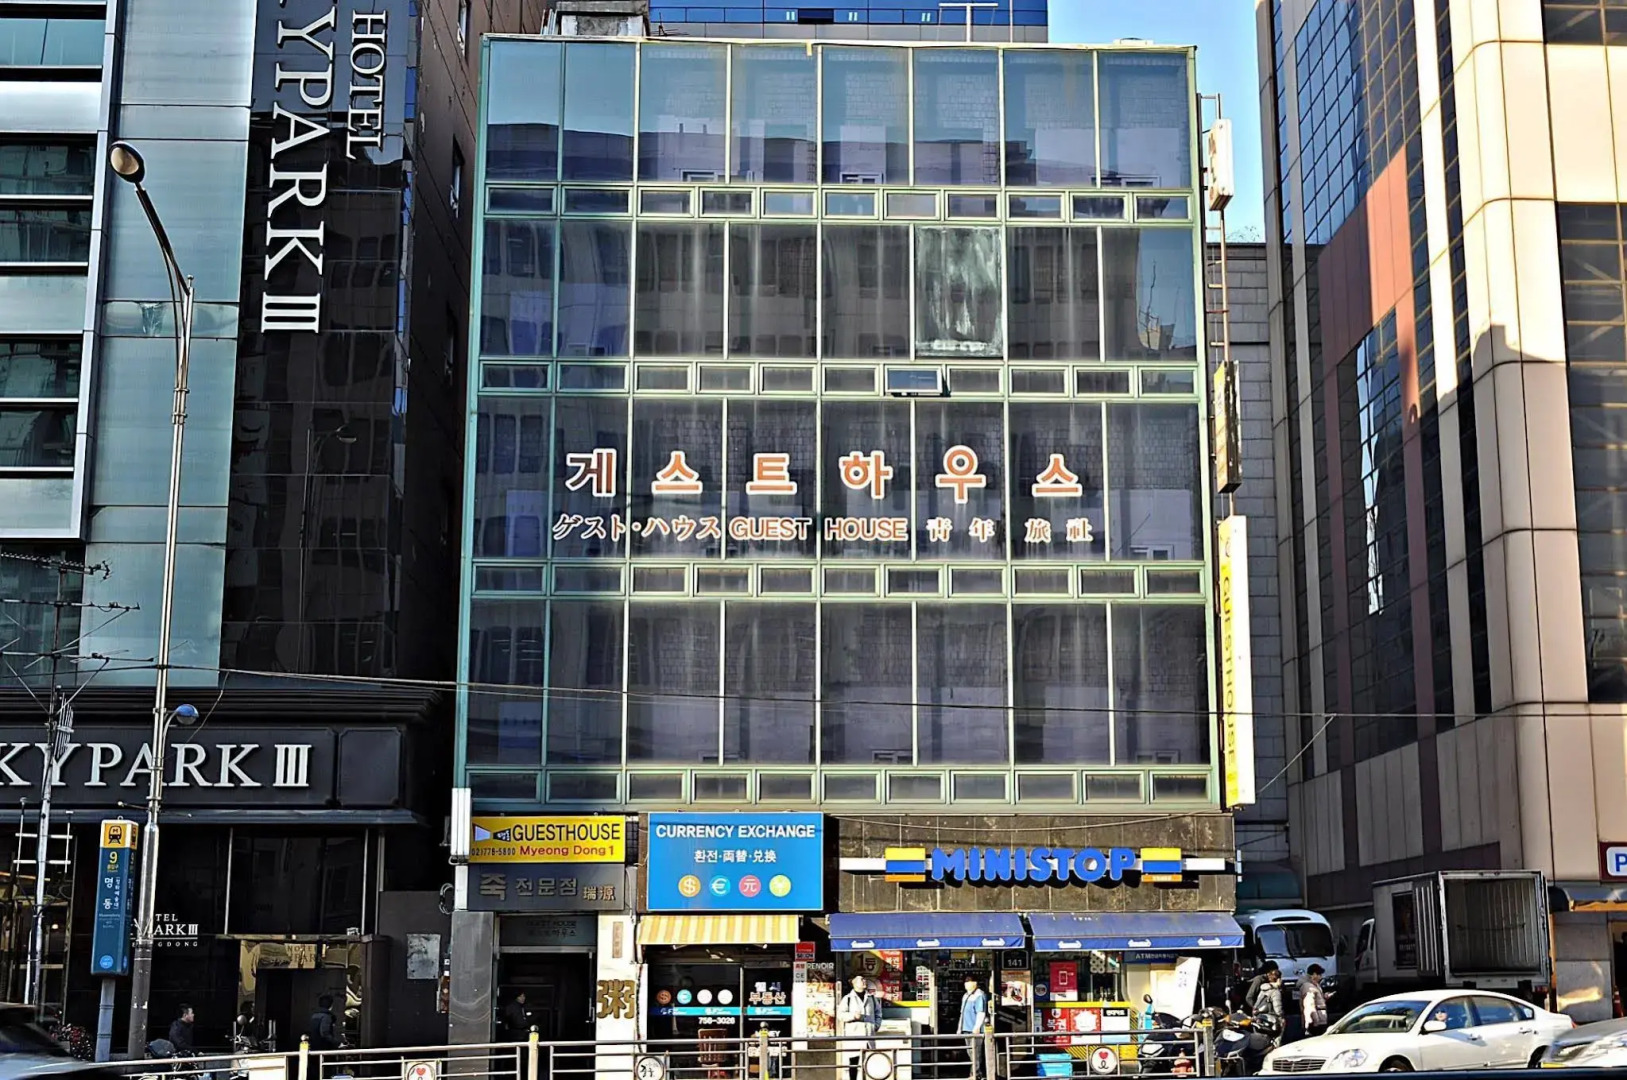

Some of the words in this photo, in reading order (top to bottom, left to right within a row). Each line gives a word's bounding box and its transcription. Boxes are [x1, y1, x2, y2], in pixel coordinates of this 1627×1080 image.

[346, 9, 388, 160] HOTEL
[264, 0, 337, 280] YPARK
[565, 445, 1083, 504] 게스트하우스
[728, 516, 813, 541] GUEST
[824, 517, 909, 541] HOUSE
[513, 824, 620, 842] GUESTHOUSE
[656, 825, 734, 838] CURRENCY
[738, 825, 815, 838] EXCHANGE
[109, 851, 118, 864] 9
[520, 846, 569, 858] Myeong
[573, 845, 606, 857] Dong
[608, 845, 615, 856] 1
[1615, 853, 1627, 872] P
[931, 846, 1137, 882] MINISTOP
[479, 874, 507, 901] 죽
[516, 878, 578, 897] 전문점
[155, 913, 178, 922] TEL
[597, 979, 635, 1019] 粥
[749, 992, 786, 1005] 부동산
